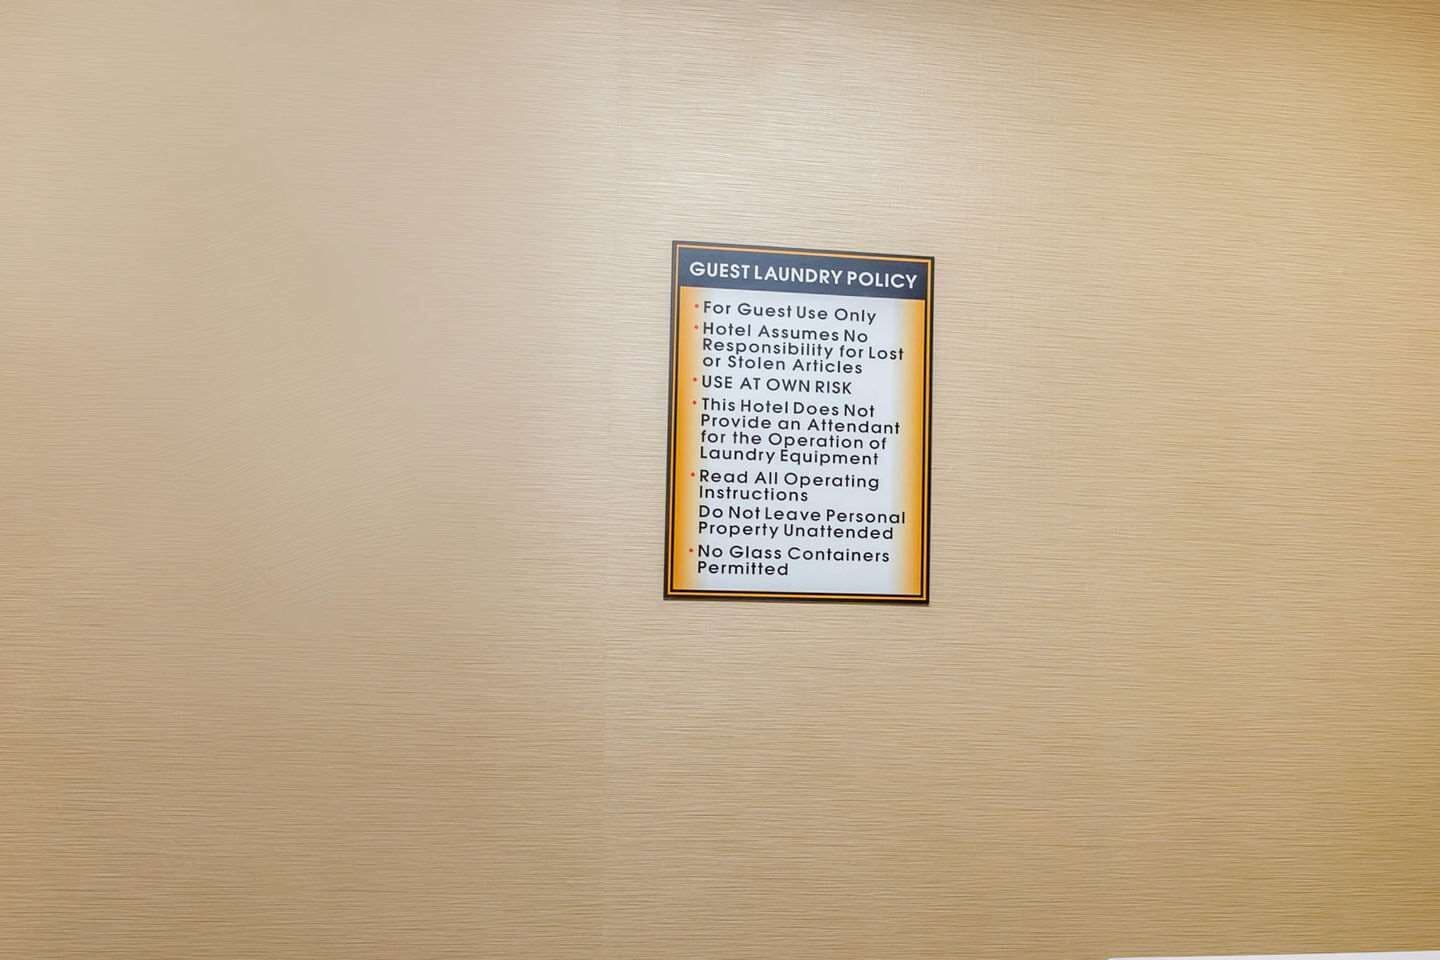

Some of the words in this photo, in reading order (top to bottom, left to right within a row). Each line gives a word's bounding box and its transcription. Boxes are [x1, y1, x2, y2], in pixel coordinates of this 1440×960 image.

[690, 261, 750, 280] GUEST
[754, 264, 843, 285] LAUNDRY
[847, 271, 918, 289] POLICY
[704, 301, 731, 314] For
[738, 302, 792, 318] Guest
[797, 306, 828, 320] Use
[834, 308, 876, 324] Only
[703, 322, 751, 337] Hotel
[758, 325, 839, 342] Assumes
[844, 329, 868, 342] No
[703, 338, 833, 359] Responsibility
[839, 345, 864, 358] for
[869, 347, 904, 360] Lost
[703, 357, 720, 367] or
[727, 356, 786, 371] Stolen
[792, 359, 863, 374] Articles
[702, 376, 733, 389] USE
[740, 377, 761, 390] AT
[766, 379, 810, 392] OWN
[815, 381, 852, 394] RISK
[701, 398, 735, 412] This
[740, 400, 789, 414] Hotel
[793, 402, 839, 416] Does
[844, 403, 875, 417] Not
[701, 414, 771, 430] Provide
[778, 419, 800, 430] an
[807, 418, 900, 435] Attendant
[701, 430, 726, 443] for
[733, 432, 762, 445] the
[768, 433, 863, 449] Operation
[869, 436, 889, 449] of
[700, 446, 775, 464] Laundry
[780, 449, 879, 466] Equipment
[700, 469, 747, 483] Read
[755, 471, 778, 485] All
[784, 472, 879, 492] Operating
[699, 486, 808, 501] Instructions
[699, 505, 723, 519] Do
[728, 506, 761, 520] Not
[765, 507, 821, 521] Leave
[826, 510, 905, 524] Personal
[698, 522, 778, 539] Property
[784, 523, 893, 540] Unattended
[698, 545, 723, 558] No
[729, 545, 781, 560] Glass
[788, 547, 890, 562] Containers
[697, 561, 788, 575] Permitted
